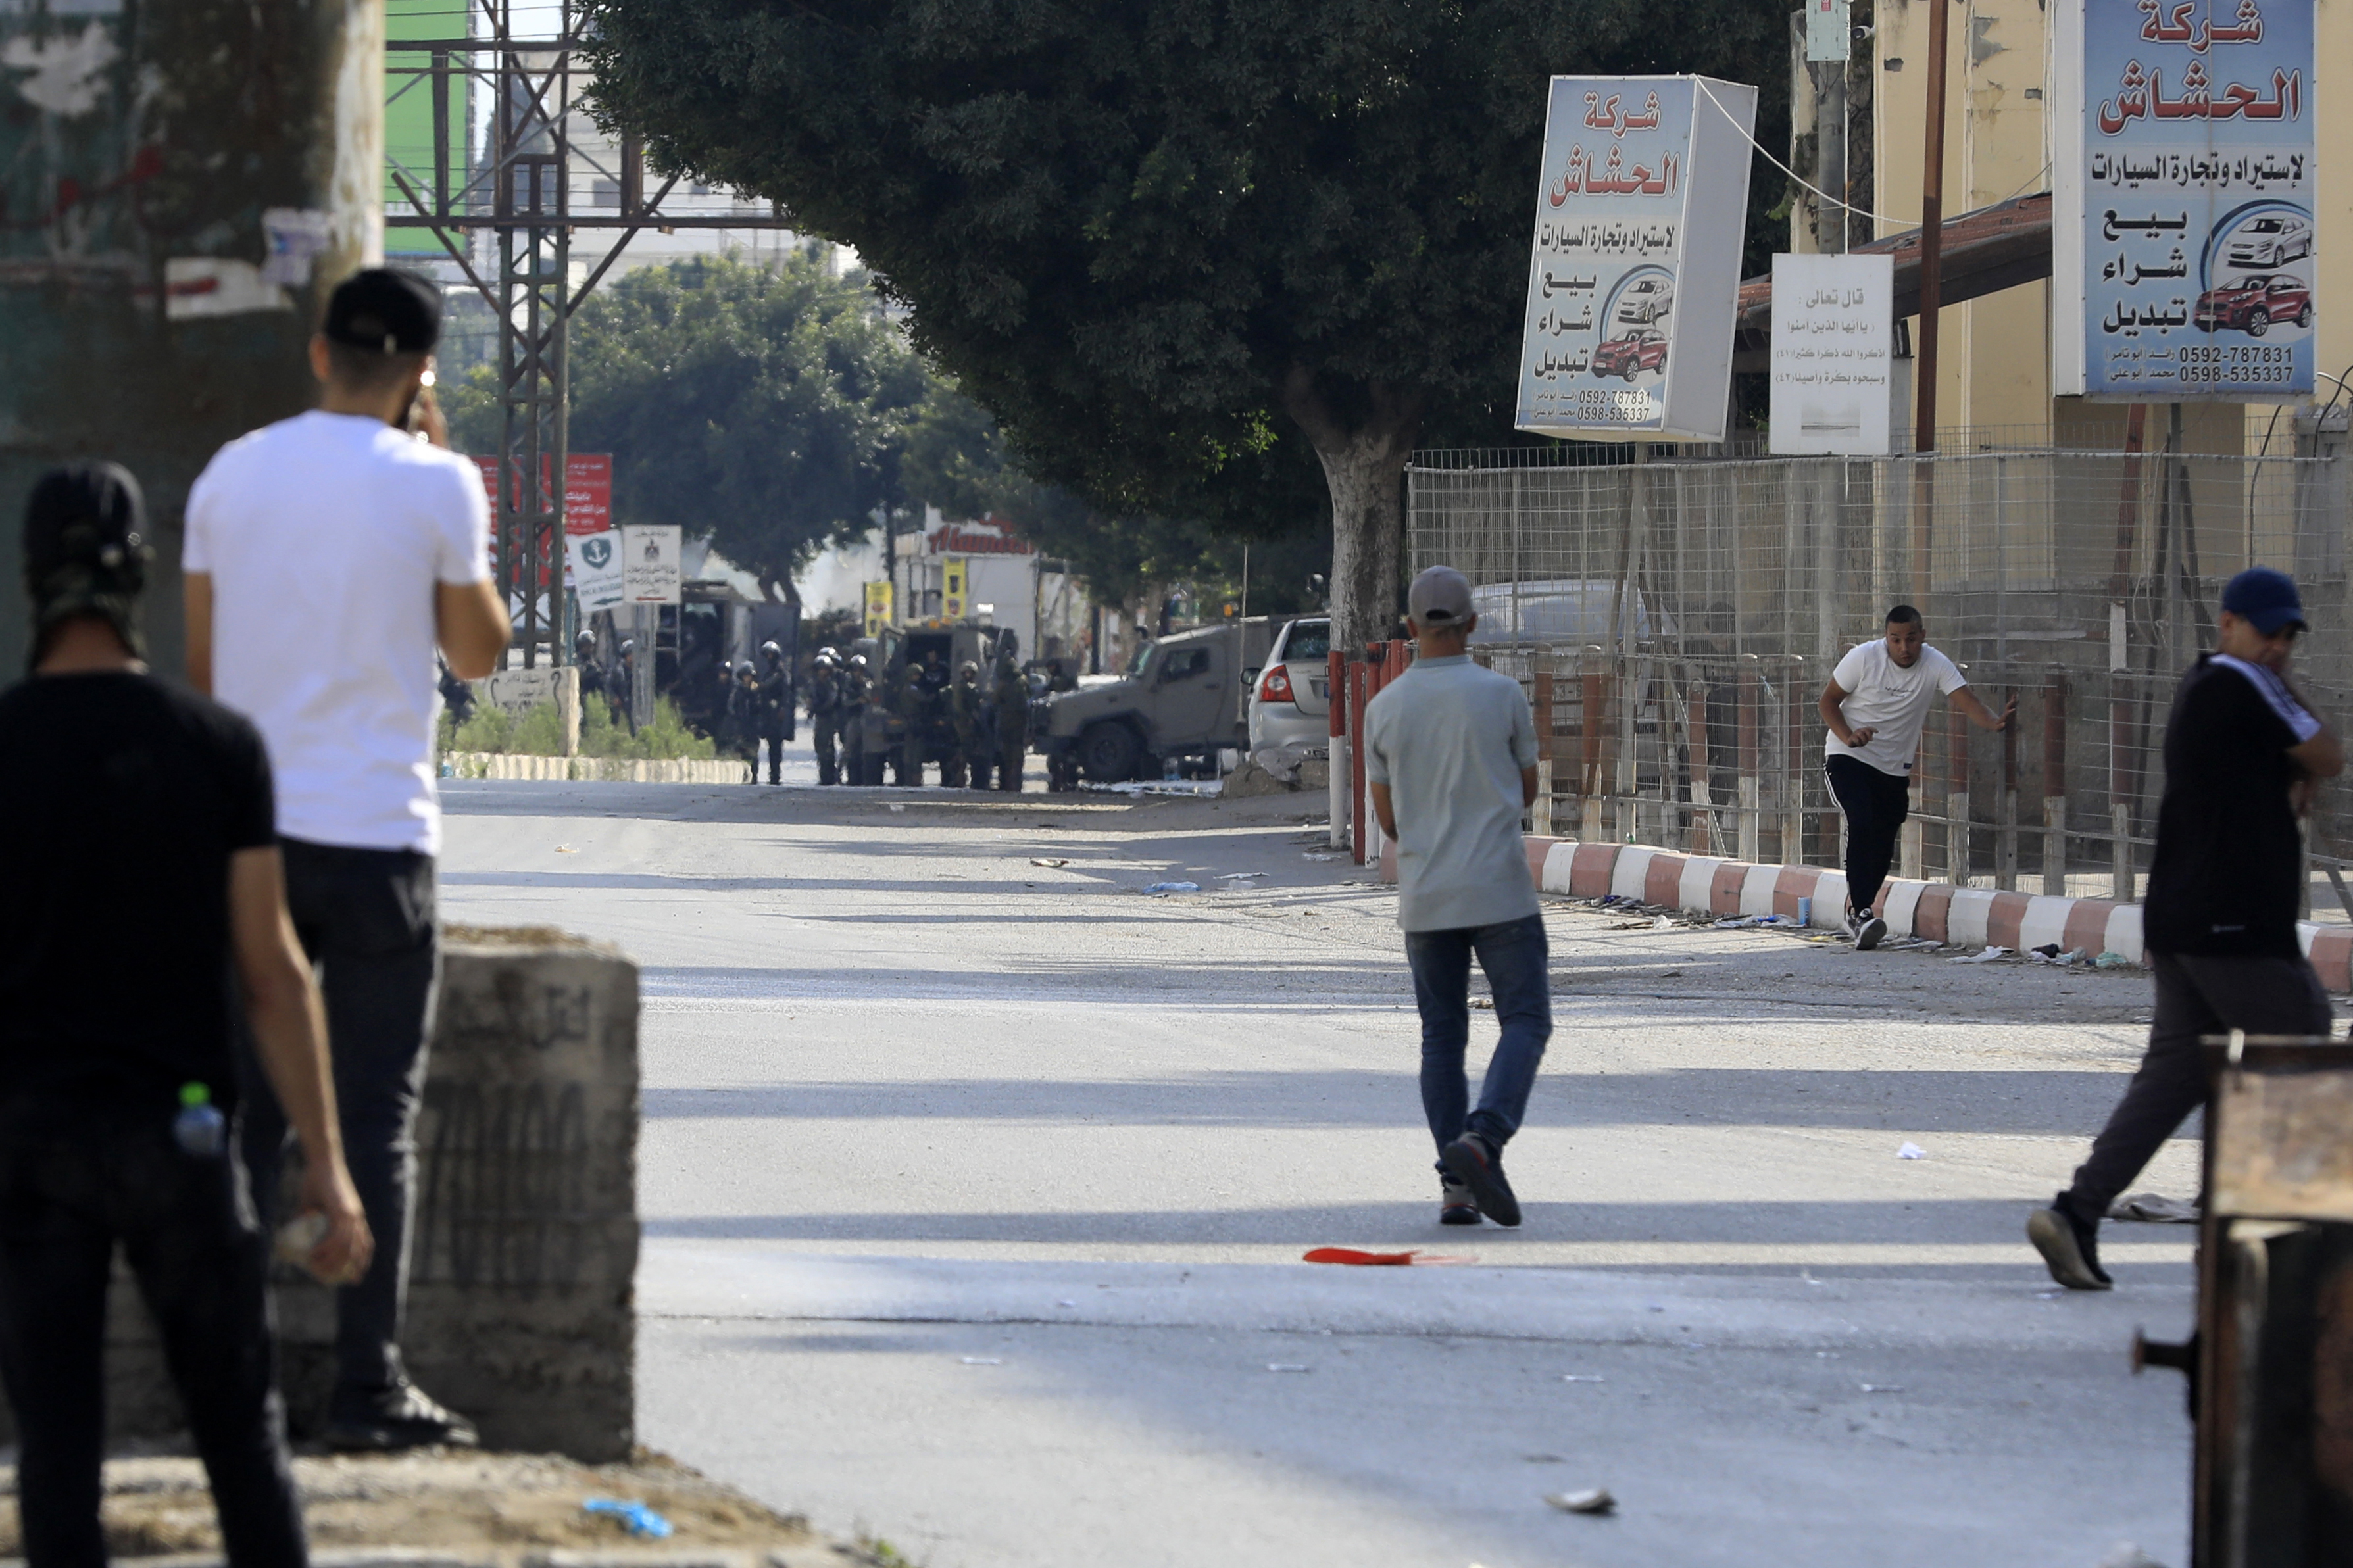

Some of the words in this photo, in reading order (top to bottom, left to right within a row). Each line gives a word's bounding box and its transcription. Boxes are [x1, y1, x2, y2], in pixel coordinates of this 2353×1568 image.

[2137, 0, 2264, 54] شركة
[2097, 59, 2300, 136] الحشاش
[1583, 91, 1660, 139] شركة
[1549, 143, 1679, 208] الحشاش
[2092, 153, 2167, 189] السيارات
[2171, 152, 2230, 187] وتجارة
[1540, 223, 1589, 254] السيارات
[1590, 222, 1627, 254] وتجارة
[2104, 210, 2187, 241] بيع
[2103, 247, 2187, 285] شراء
[1543, 272, 1597, 298] بيع
[1806, 289, 1838, 308] تعالى
[1842, 288, 1864, 308] قال
[1539, 305, 1593, 337] شراء
[2104, 298, 2187, 337] تبديل
[1535, 347, 1588, 380] تبديل
[1842, 349, 1855, 358] الله
[2179, 347, 2293, 363] 0592-787831
[2149, 369, 2175, 378] محمد
[2179, 366, 2294, 382] 0598-535337
[1579, 390, 1650, 405] 0592-787831
[1577, 406, 1650, 422] 0598-535337
